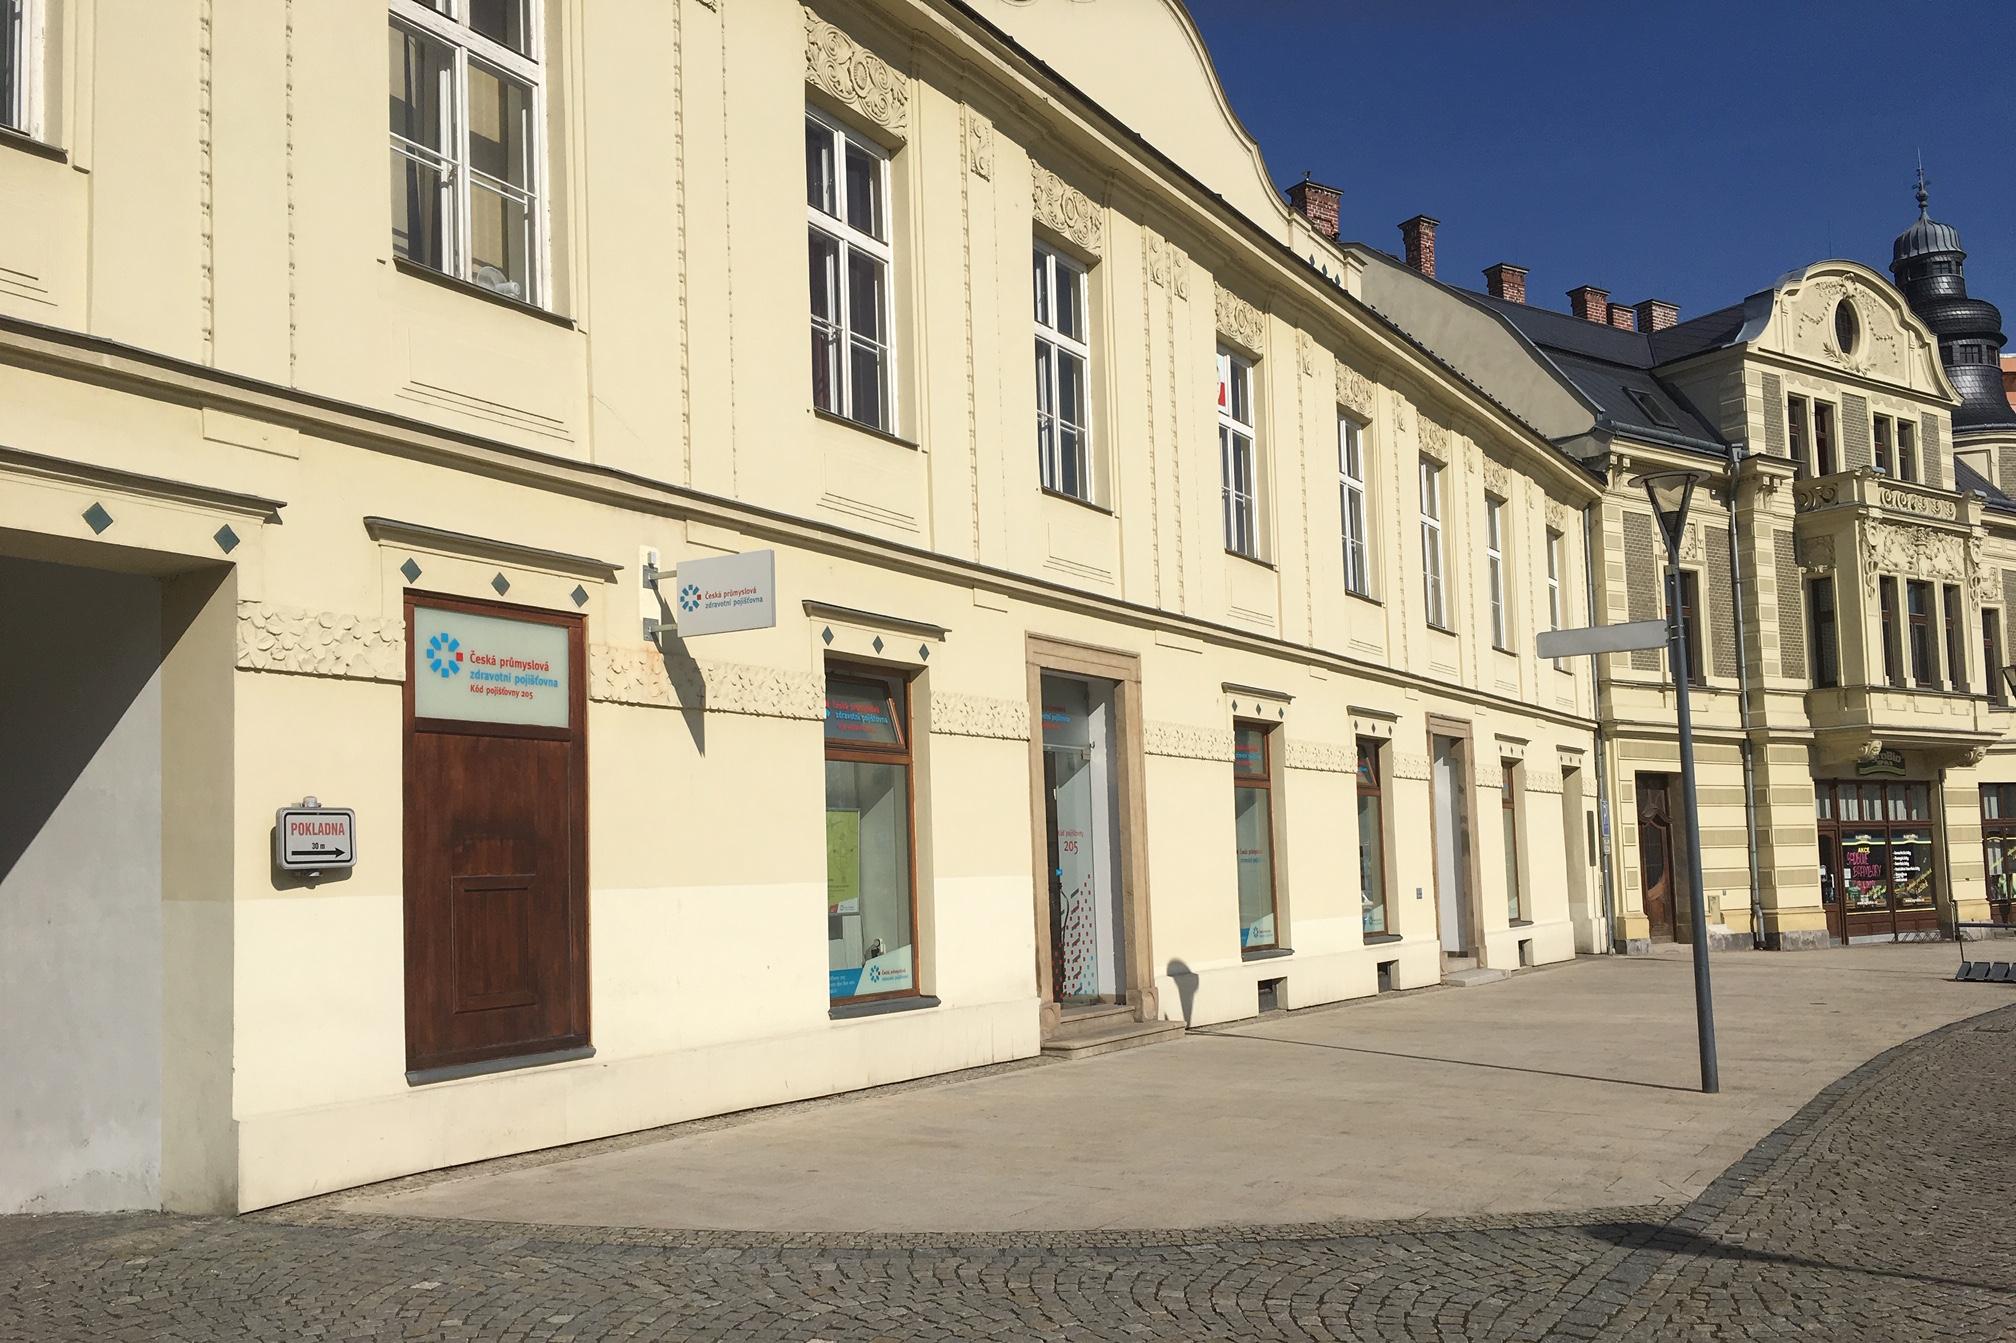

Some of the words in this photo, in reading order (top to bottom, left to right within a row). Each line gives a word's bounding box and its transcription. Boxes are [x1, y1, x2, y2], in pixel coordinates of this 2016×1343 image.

[705, 591, 722, 600] Česká
[724, 586, 757, 599] průmyslová
[705, 600, 732, 609] zdravotní
[734, 596, 764, 607] pojišťovna
[470, 650, 496, 666] Česká
[499, 657, 549, 672] průmyslová
[470, 669, 512, 683] zdravotní
[514, 673, 559, 688] pojišťovna
[470, 684, 484, 693] Kód
[486, 686, 520, 698] pojišťovny
[521, 690, 534, 700] 205
[291, 822, 345, 836] POKLADNA
[312, 842, 319, 850] 30
[1064, 841, 1078, 855] 205
